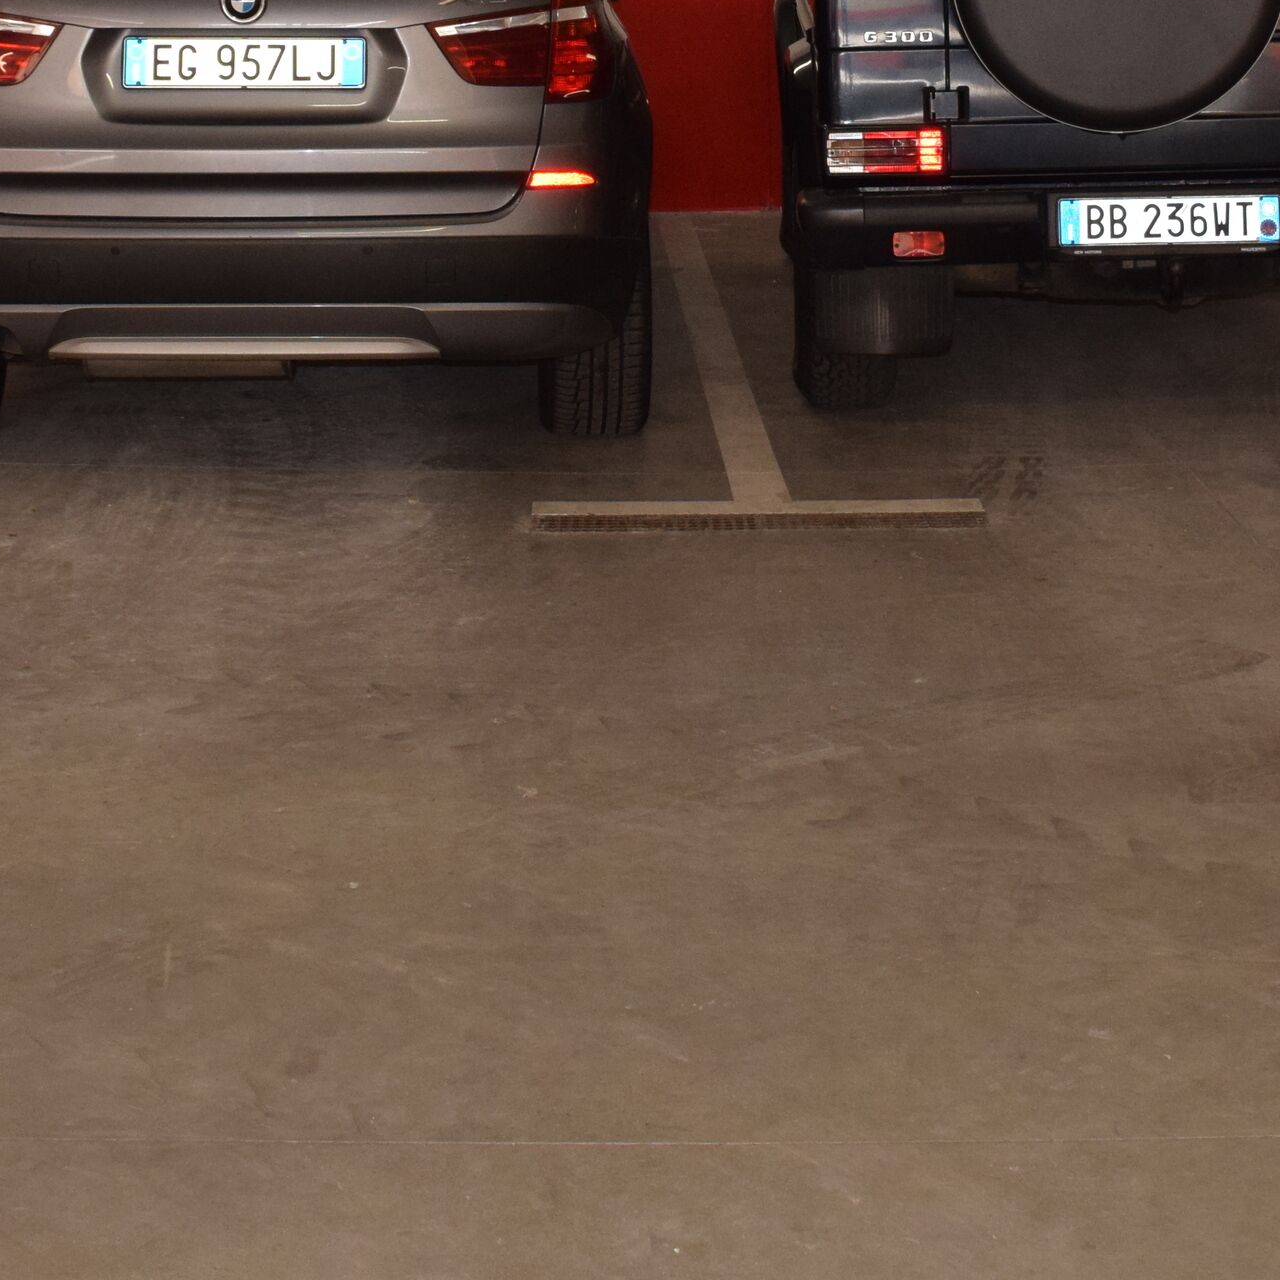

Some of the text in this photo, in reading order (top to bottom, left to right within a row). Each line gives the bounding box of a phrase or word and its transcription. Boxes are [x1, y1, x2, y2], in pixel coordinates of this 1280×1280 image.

[152, 44, 336, 81] EG 957LJ
[1086, 202, 1253, 239] BB 236WT
